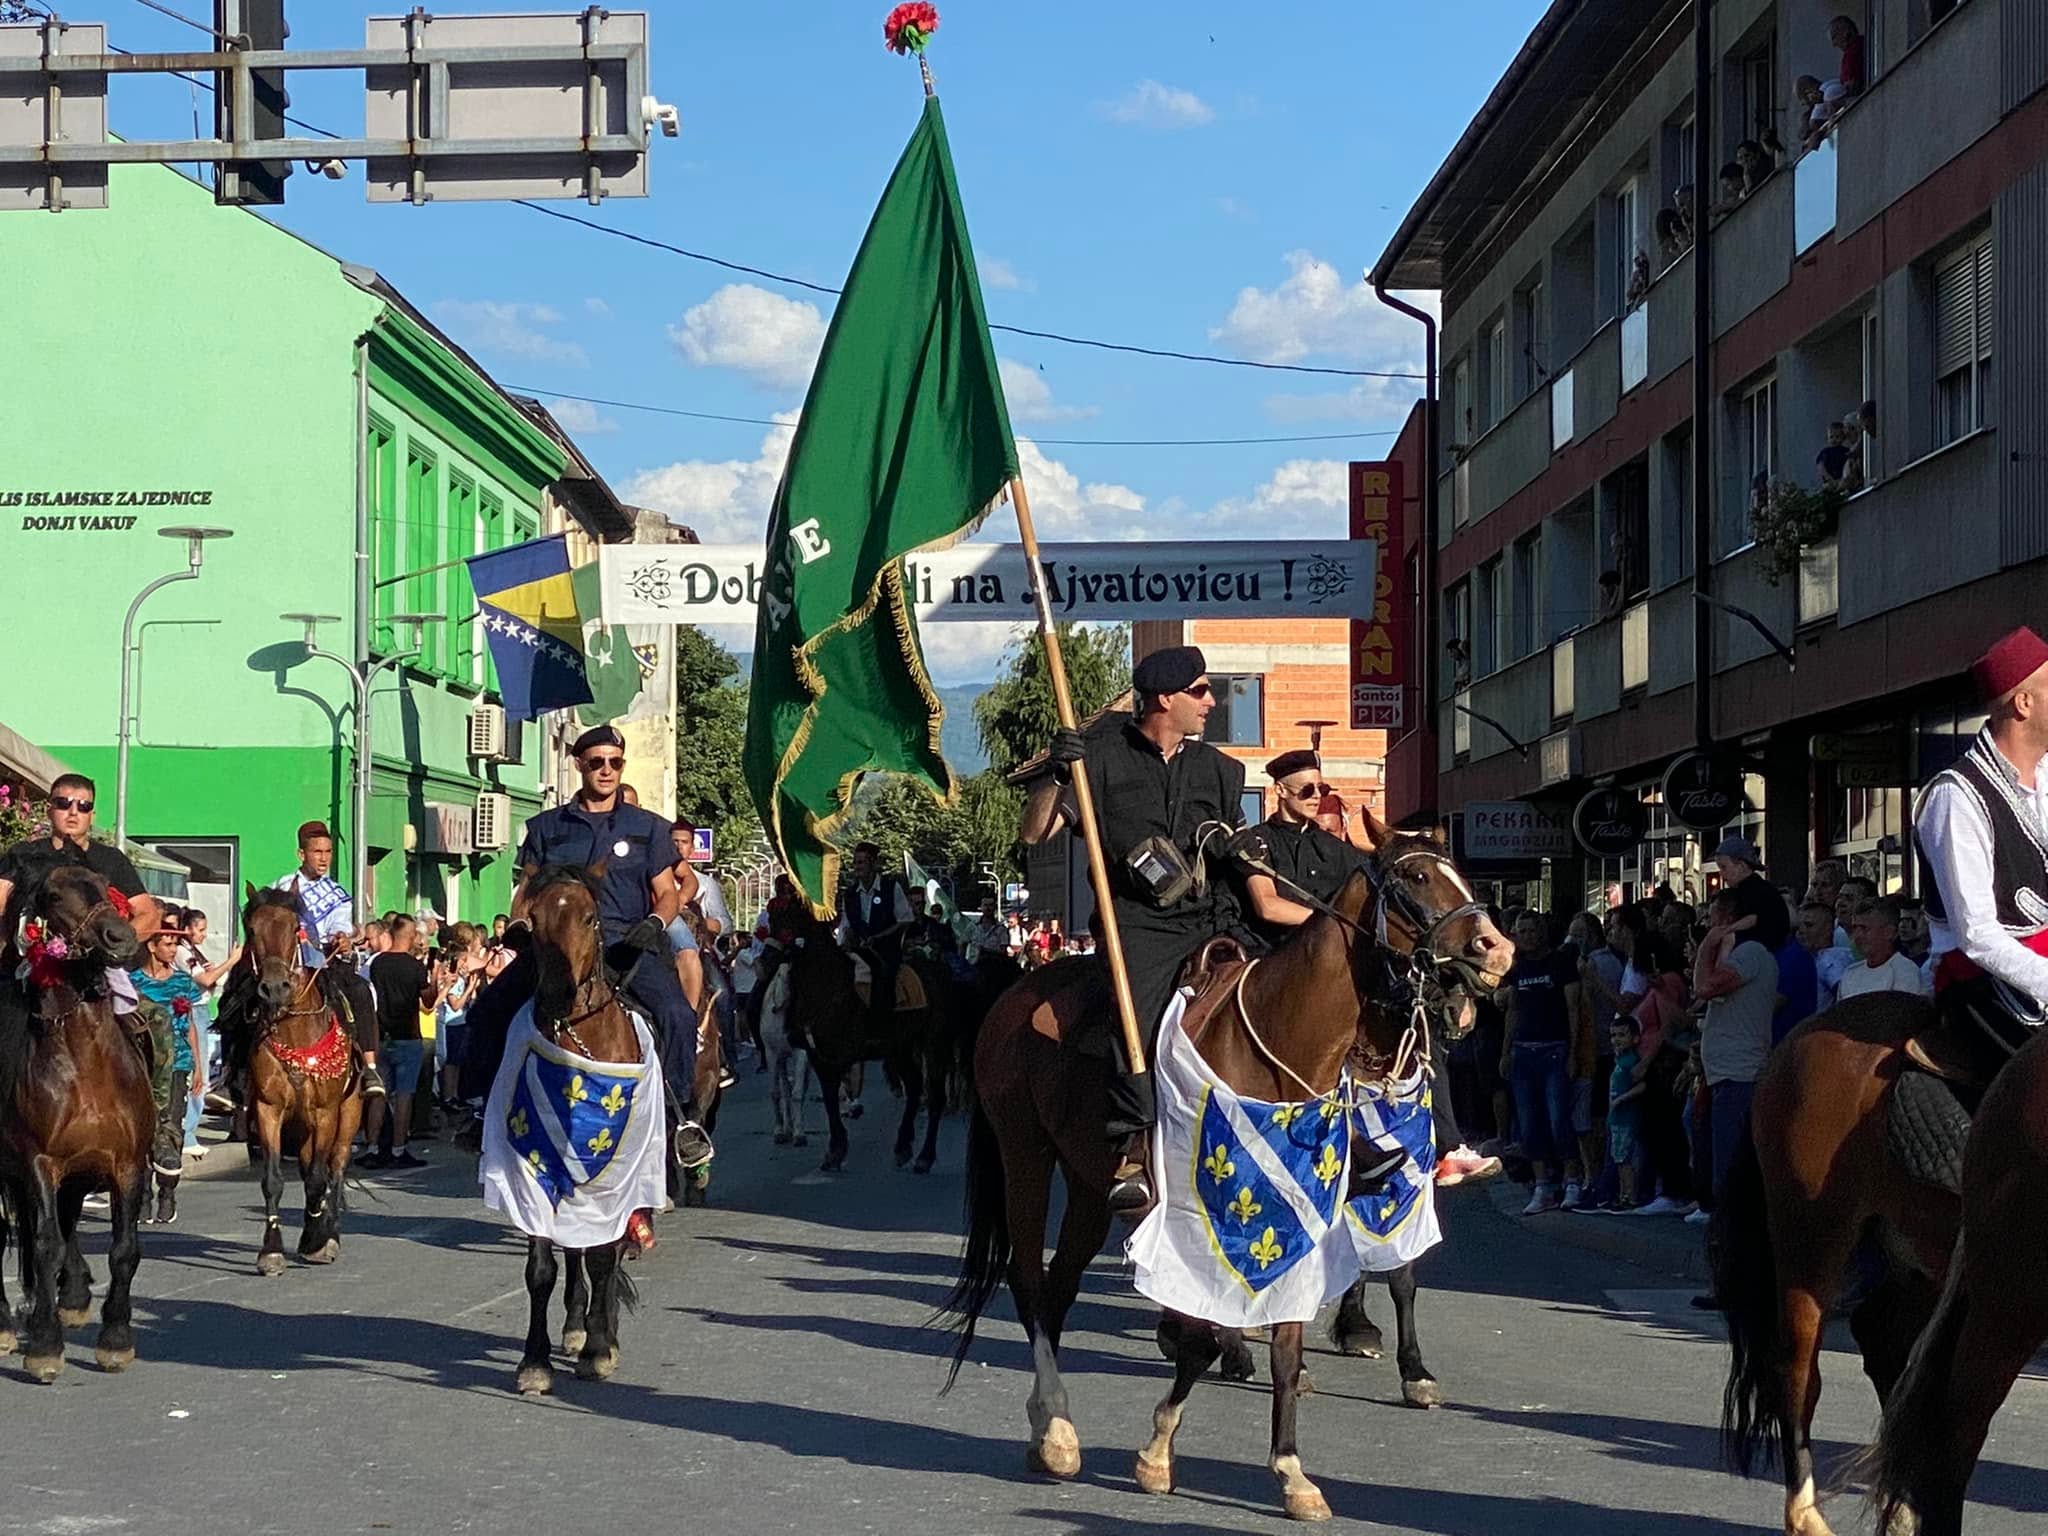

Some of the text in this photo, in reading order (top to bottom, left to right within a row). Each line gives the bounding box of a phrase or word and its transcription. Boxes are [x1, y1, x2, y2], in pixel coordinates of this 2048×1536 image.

[25, 491, 114, 506] ISLAMSKE
[114, 491, 213, 506] ZAJEDNICE
[22, 516, 138, 530] DONJI VAKUF
[680, 561, 768, 605] Dob
[952, 572, 1005, 605] na
[1021, 560, 1262, 613] Ajvatovicu
[1281, 559, 1297, 601] !
[1353, 690, 1400, 702] Santos
[1679, 788, 1728, 816] Taste
[1475, 811, 1565, 829] PEKARA
[1589, 819, 1633, 842] Taste
